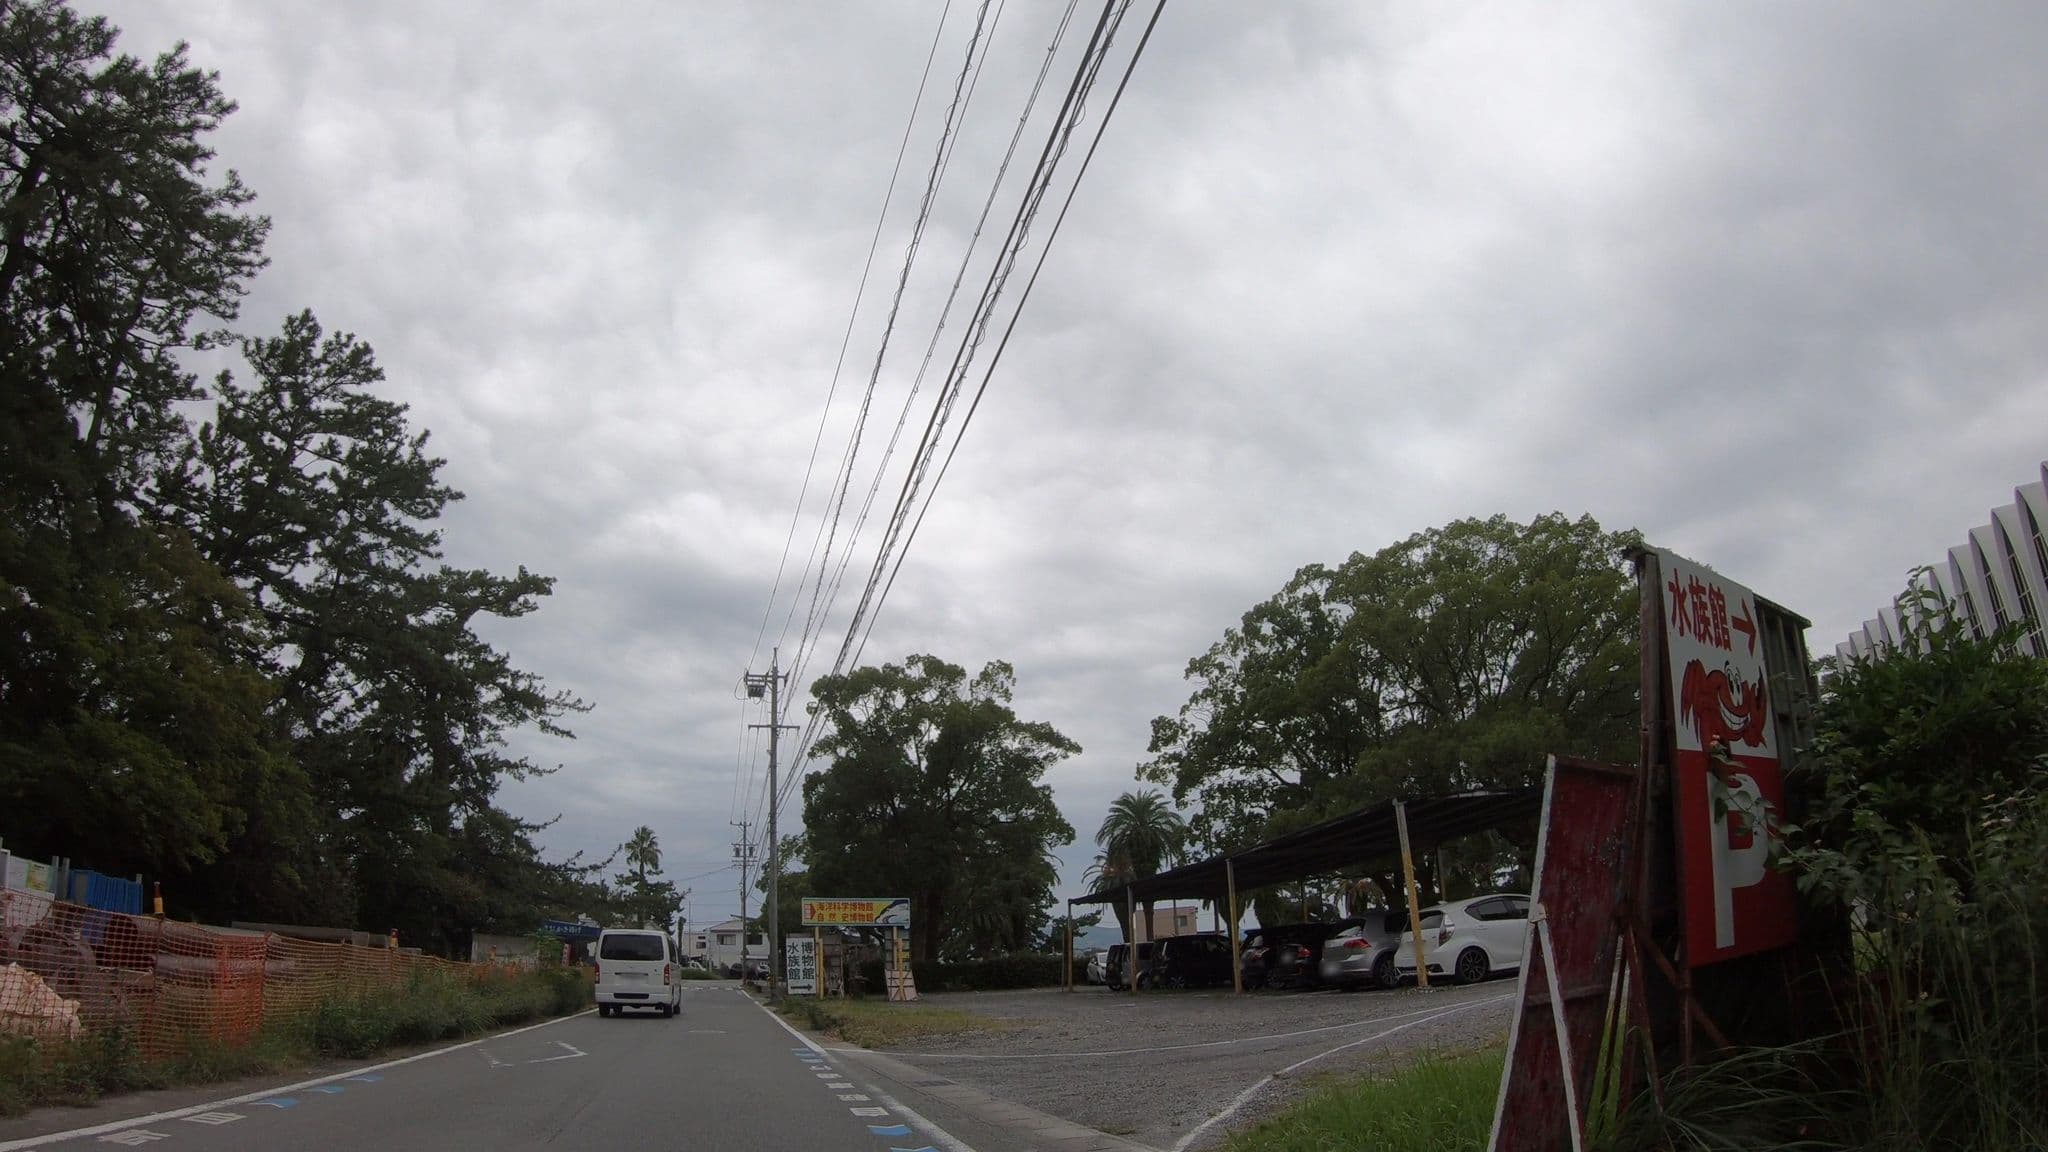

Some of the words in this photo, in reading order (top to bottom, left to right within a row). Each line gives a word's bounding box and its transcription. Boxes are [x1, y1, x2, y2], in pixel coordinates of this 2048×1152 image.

[1668, 568, 1732, 651] 水族館
[1706, 771, 1768, 949] P
[816, 903, 873, 912] 海洋科学博物館
[788, 942, 800, 980] 水族館
[801, 941, 815, 980] 博物館
